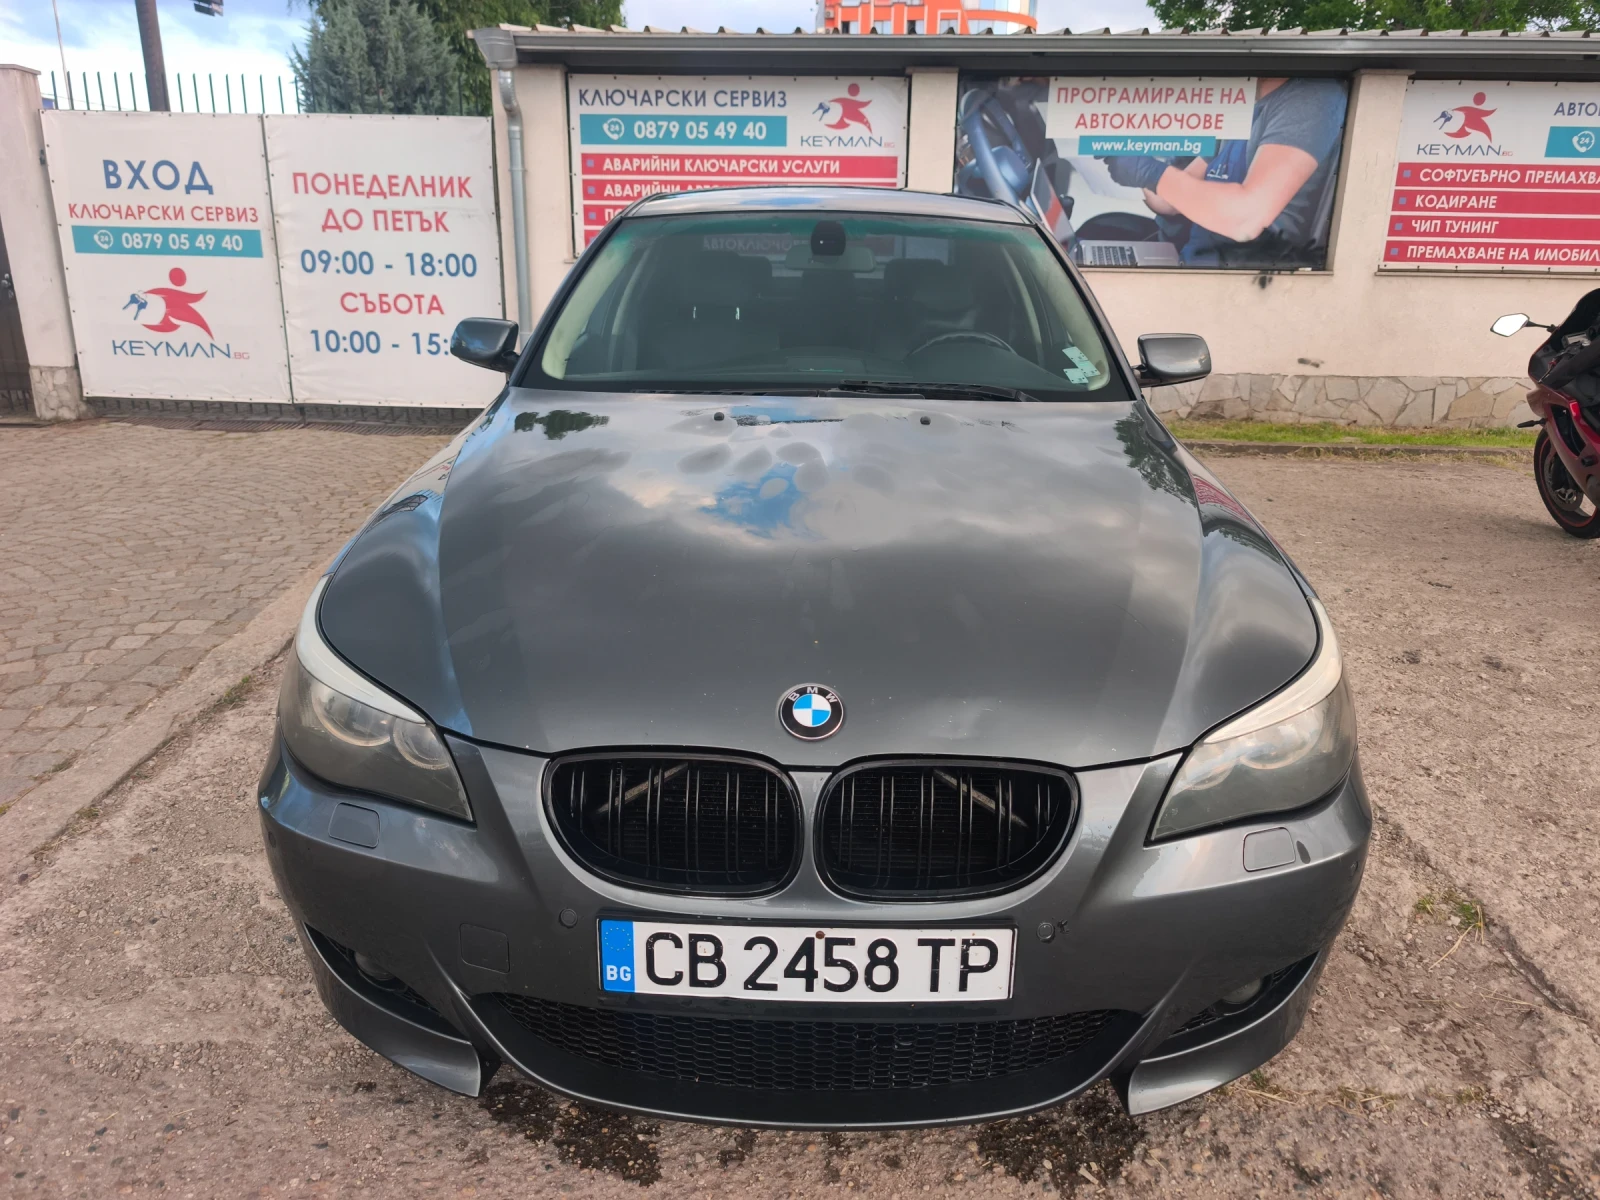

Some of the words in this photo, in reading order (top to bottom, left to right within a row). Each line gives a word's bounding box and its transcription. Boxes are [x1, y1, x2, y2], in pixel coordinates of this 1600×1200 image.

[578, 89, 706, 107] КЛЮЧАРСКИ
[714, 90, 787, 108] СЕРВИЗ
[1056, 87, 1214, 104] ПРОГРАМИРАНЕ
[1219, 87, 1247, 104] НА
[633, 121, 680, 139] 0879
[685, 121, 709, 140] 05
[714, 122, 738, 140] 49
[743, 122, 767, 140] 40
[1075, 113, 1225, 130] АВТОКЛЮЧОВЕ
[1091, 138, 1202, 154] www.keyman.bg
[602, 155, 681, 172] АВАРИЙНИ
[684, 158, 778, 174] КЛЮЧАРСКИ
[782, 159, 840, 174] УСЛУГИ
[102, 159, 214, 196] ВХОД
[1419, 168, 1521, 183] СОФТУЕЪРНО
[292, 172, 473, 199] ПОНЕДЕЛНИК
[1415, 194, 1498, 210] КОДИРАНЕ
[68, 203, 185, 222] КЛЮЧАРСКИ
[190, 205, 259, 223] СЕРВИЗ
[321, 208, 364, 233] ДО
[372, 209, 450, 233] ПЕТЪК
[1411, 219, 1441, 233] ЧИП
[1445, 220, 1500, 234] ТУНИНГ
[121, 232, 163, 250] 0879
[168, 233, 190, 250] 05
[195, 234, 216, 250] 49
[221, 235, 243, 252] 40
[1406, 245, 1506, 260] ПРЕМАХВАНЕ
[1508, 246, 1530, 261] НА
[1533, 247, 1600, 262] ИМОБИЛ
[301, 249, 374, 275] 09:00
[405, 252, 477, 278] 18:00
[340, 291, 445, 316] СЪБОТА
[310, 329, 381, 354] 10:00
[411, 332, 449, 356] 15:
[787, 685, 839, 703] BMW
[645, 931, 727, 988] CB
[743, 935, 899, 993] 2458
[917, 937, 999, 993] TP
[606, 965, 632, 982] BG
